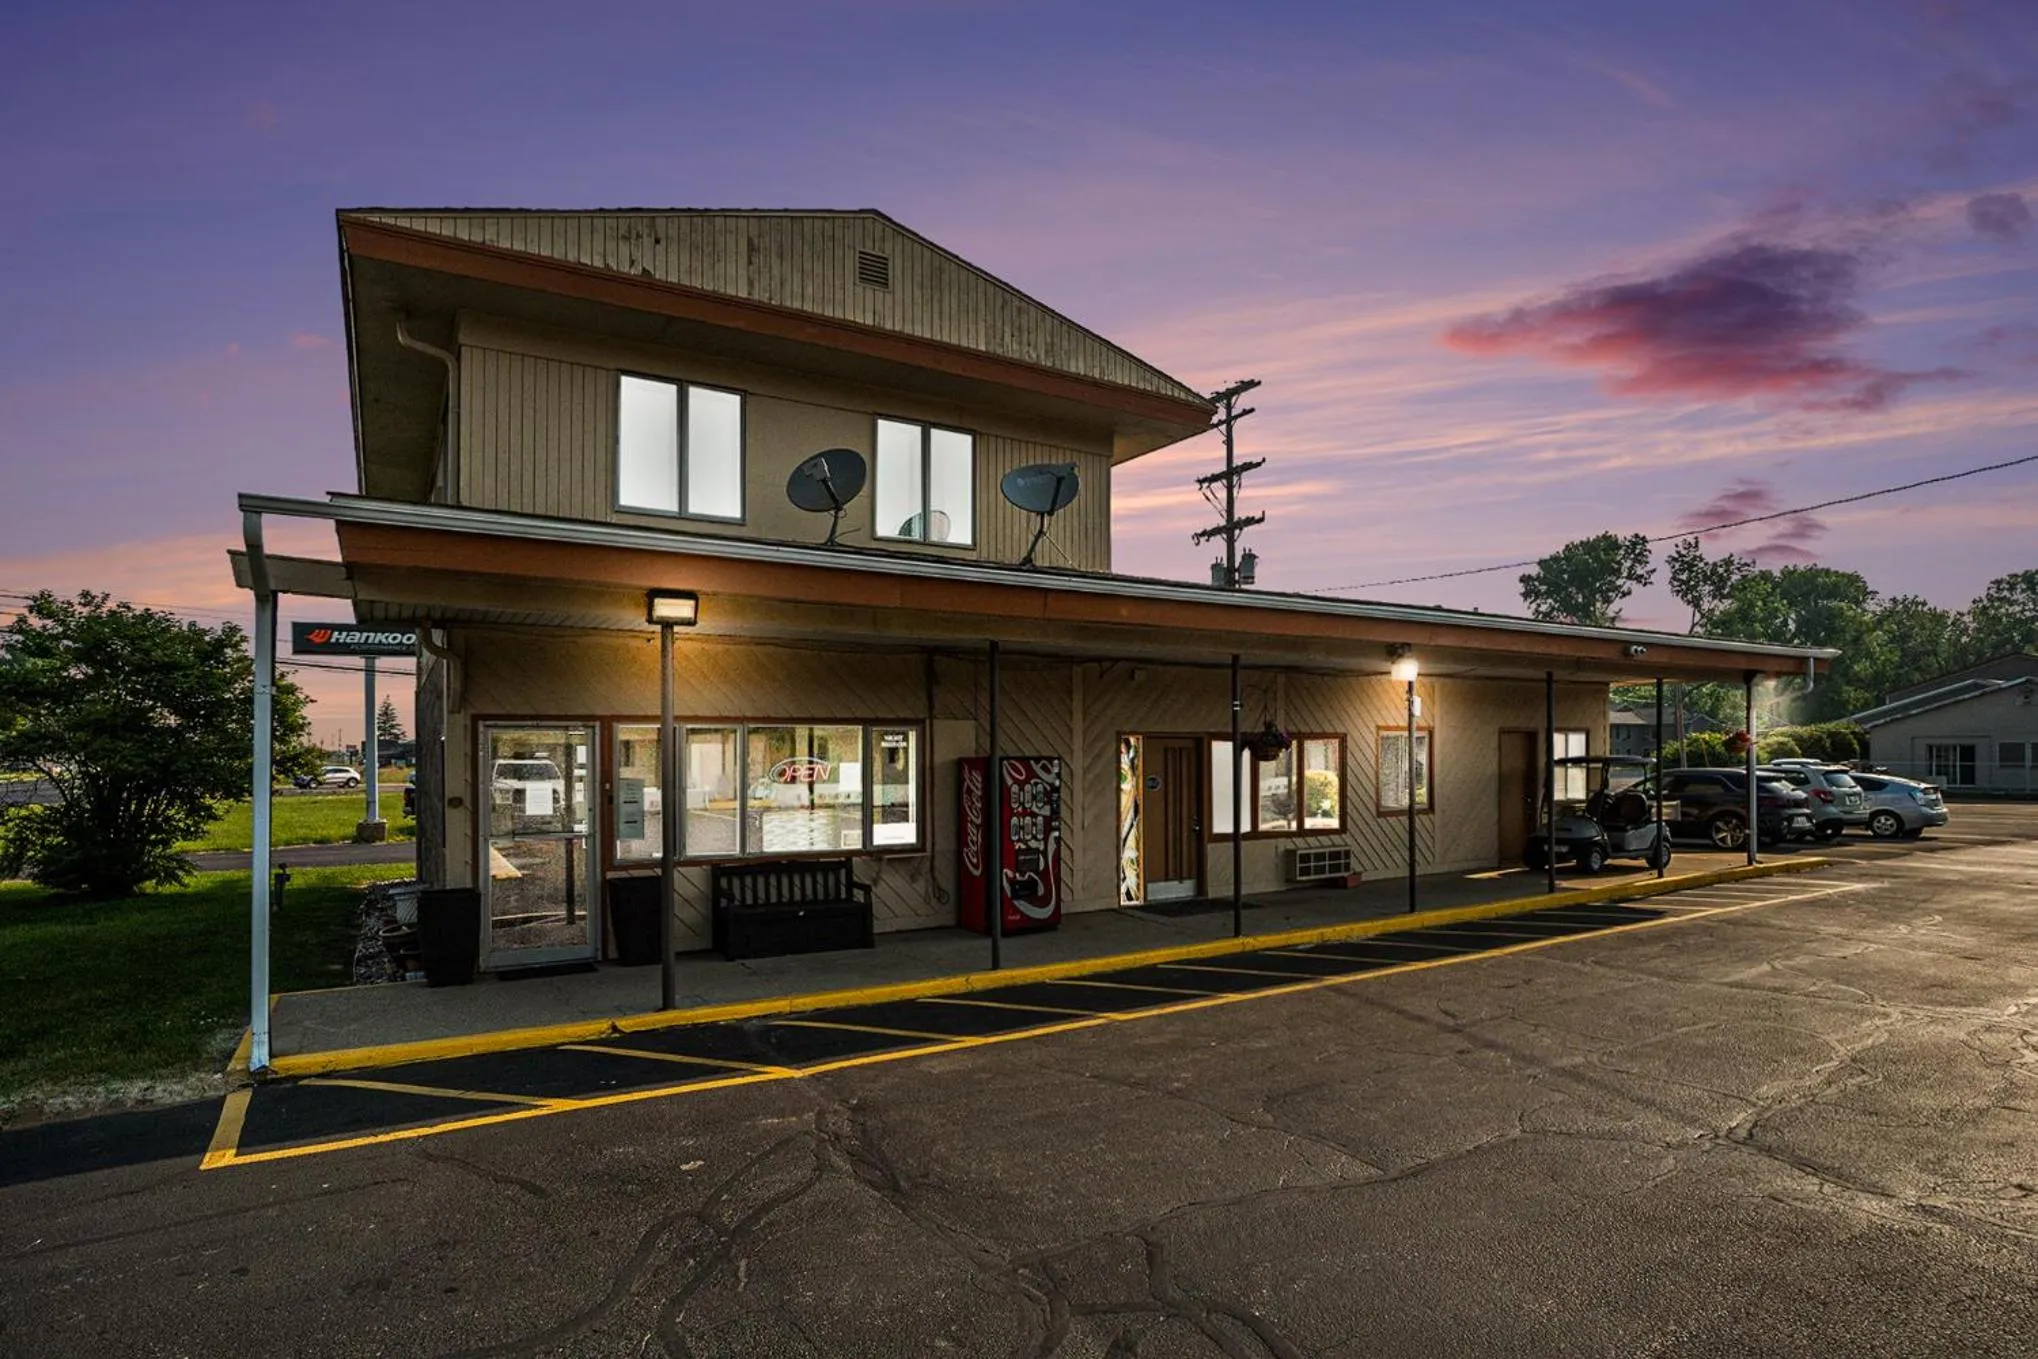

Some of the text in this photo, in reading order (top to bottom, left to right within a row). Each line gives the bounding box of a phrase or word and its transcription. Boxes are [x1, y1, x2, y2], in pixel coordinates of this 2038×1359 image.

[330, 631, 417, 644] Hankoo
[775, 763, 831, 783] OPEN
[962, 764, 983, 877] Coca-Cola
